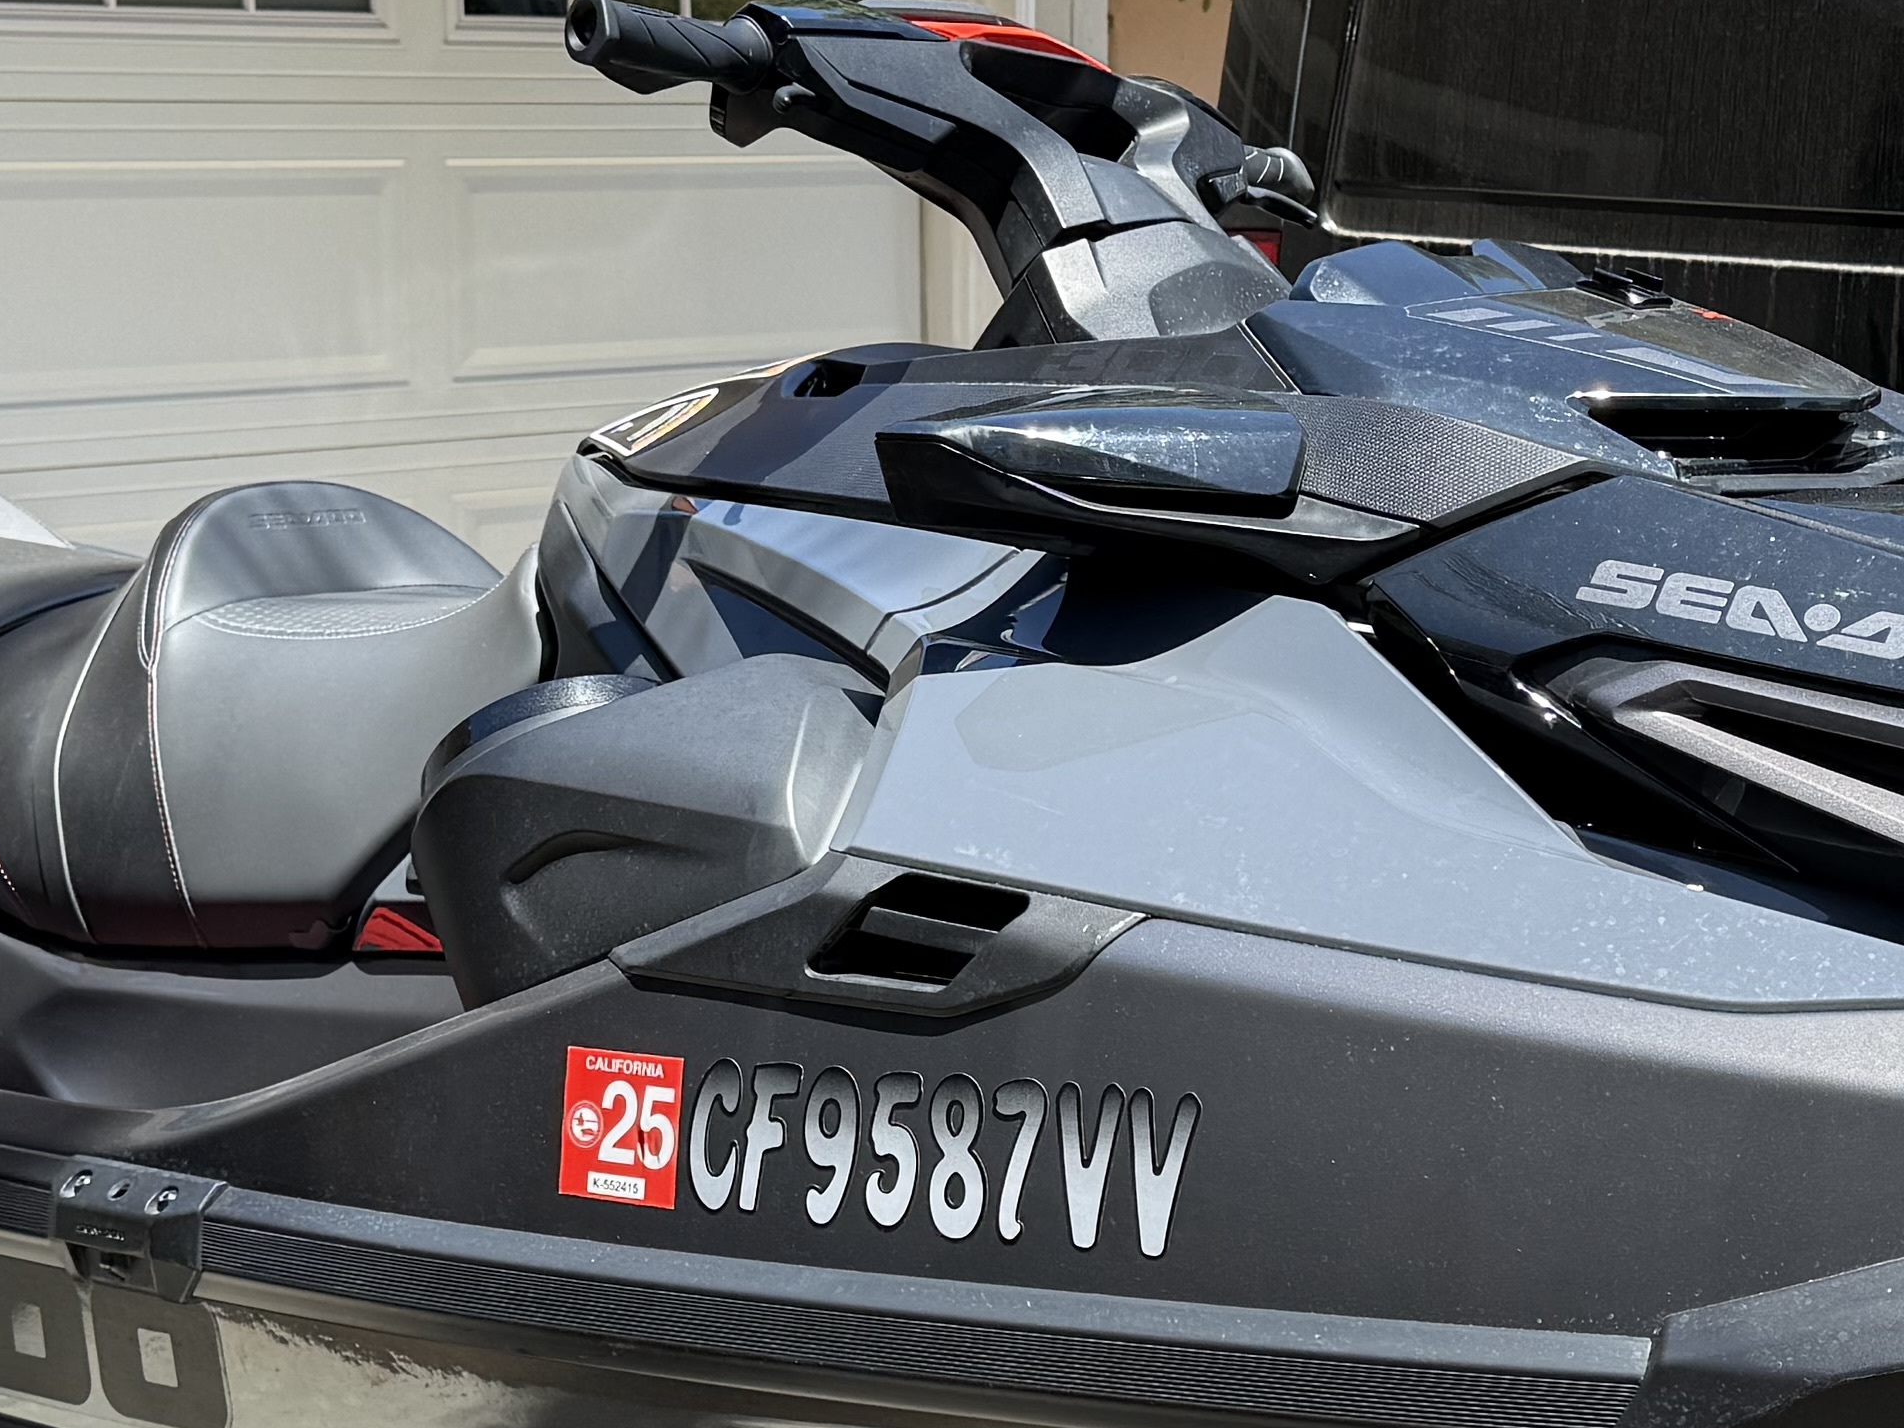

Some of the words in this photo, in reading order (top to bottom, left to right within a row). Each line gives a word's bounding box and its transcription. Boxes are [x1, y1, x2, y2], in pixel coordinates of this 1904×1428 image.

[585, 1055, 665, 1079] CALIFORNIA
[597, 1079, 676, 1170] 25
[689, 1056, 1203, 1259] CF9587VV
